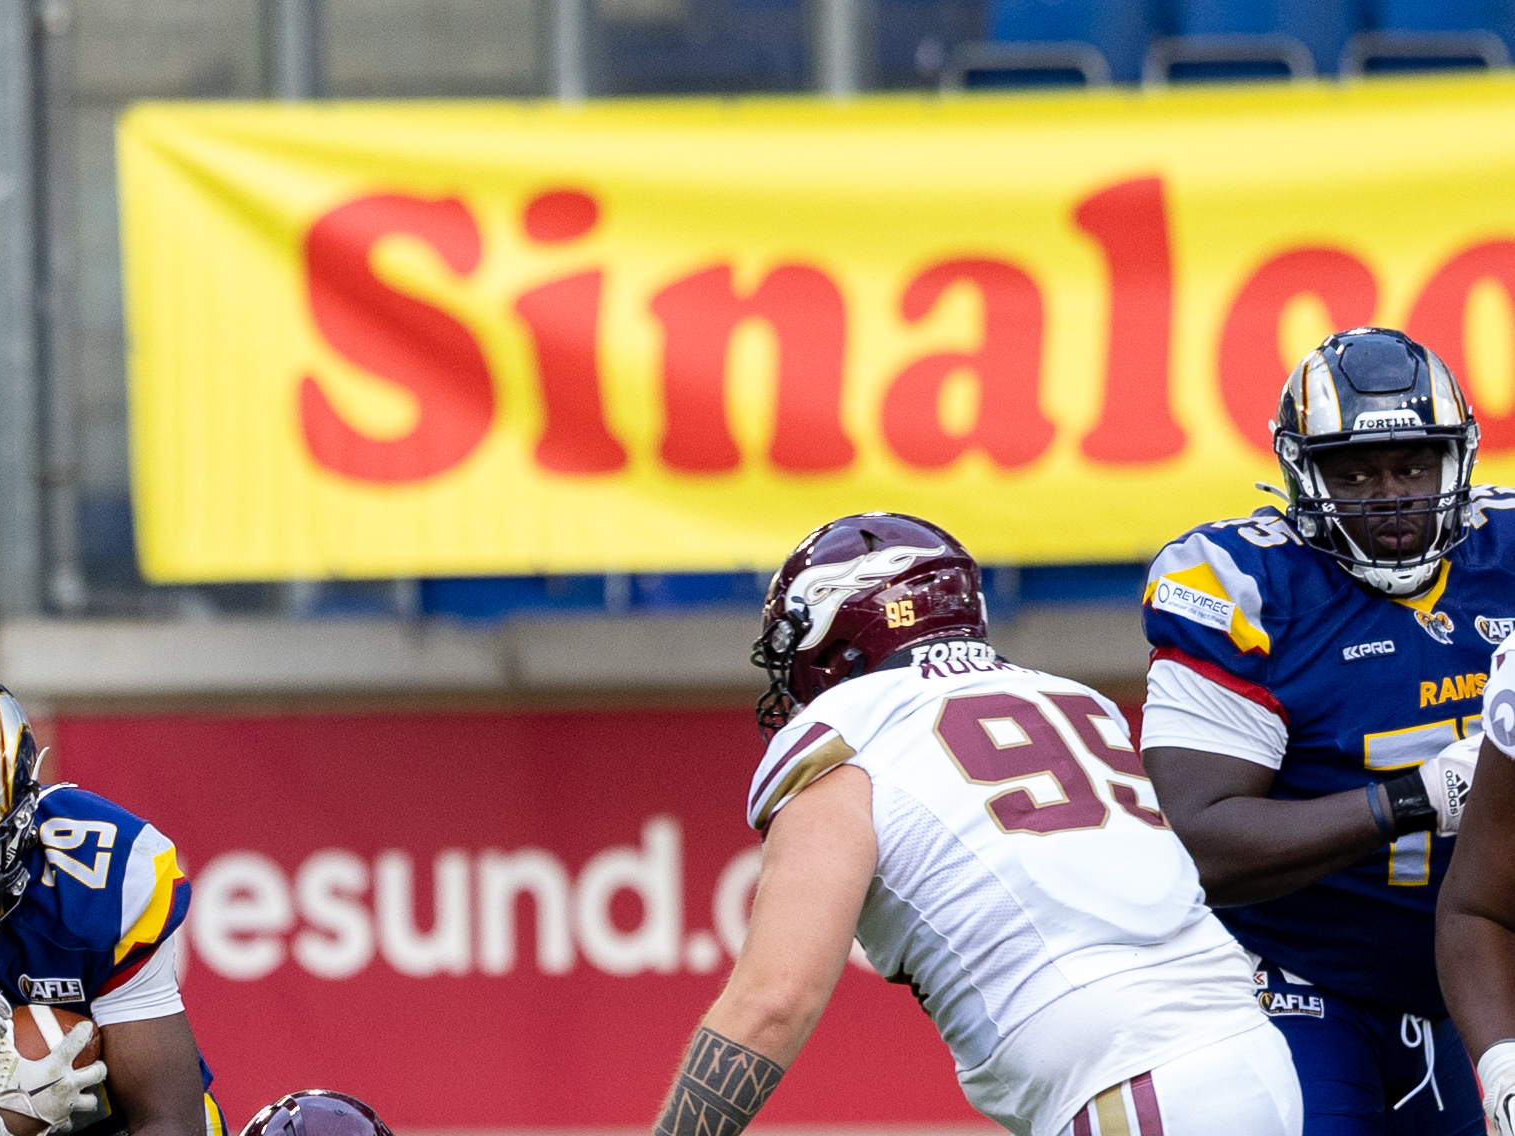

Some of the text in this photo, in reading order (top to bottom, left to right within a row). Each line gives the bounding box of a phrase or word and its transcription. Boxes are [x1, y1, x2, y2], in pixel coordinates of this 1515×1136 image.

[1358, 417, 1416, 428] FORELLE
[885, 600, 916, 629] 95
[1172, 587, 1230, 616] REVIREC
[1419, 673, 1488, 708] RAMS
[932, 690, 1174, 838] 95
[1444, 769, 1458, 815] adidas
[40, 817, 118, 889] 29
[30, 980, 81, 999] AFLE
[1269, 992, 1321, 1011] AFLE
